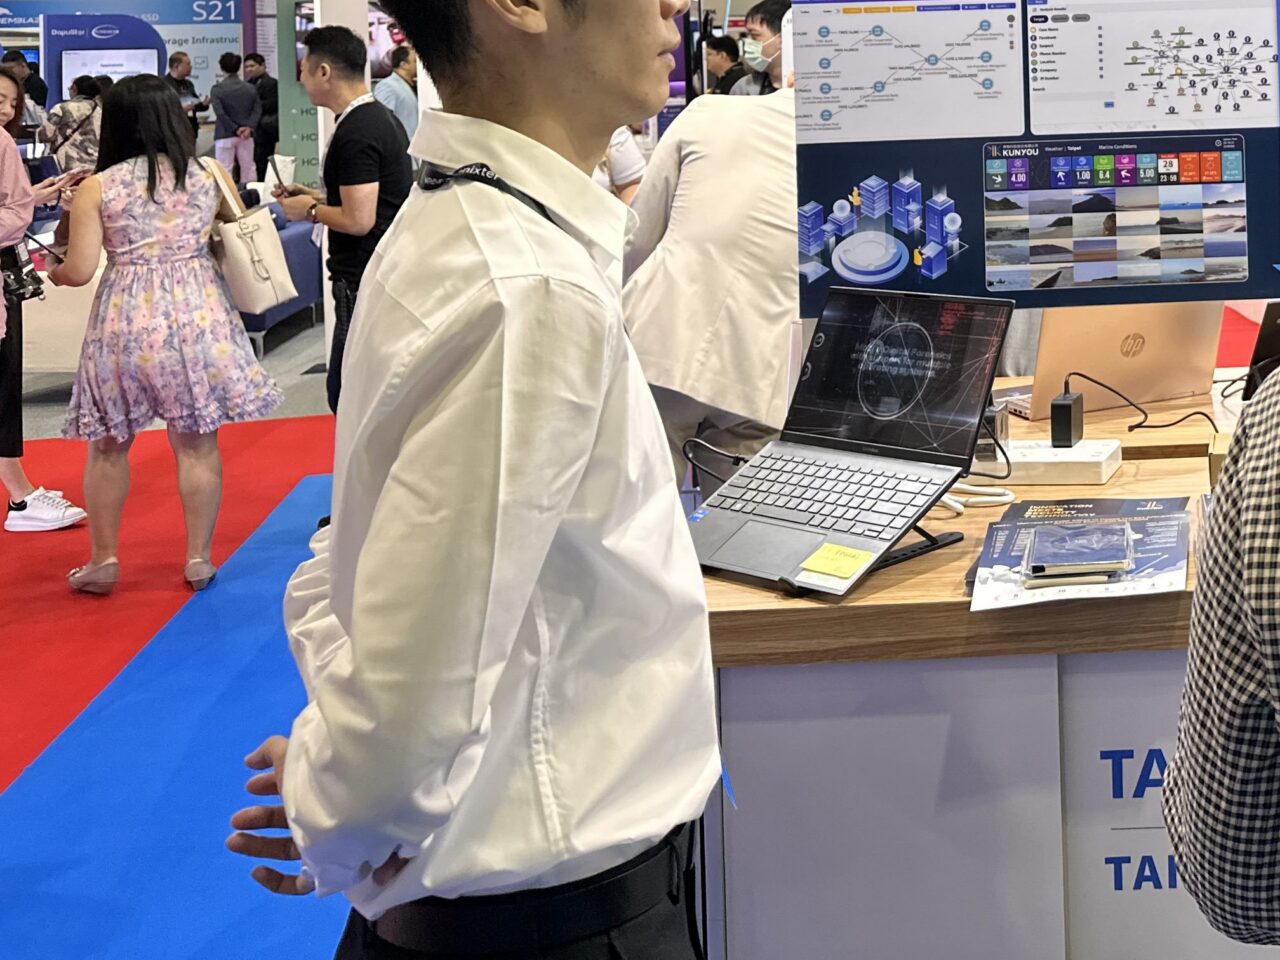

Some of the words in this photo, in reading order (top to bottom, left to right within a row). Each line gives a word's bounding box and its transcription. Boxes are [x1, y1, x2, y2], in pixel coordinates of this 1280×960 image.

[192, 0, 236, 21] S21
[164, 37, 189, 47] orage
[192, 36, 239, 45] Infrastruc
[1003, 148, 1039, 157] KUNYOU
[1011, 173, 1026, 182] 4.00
[1076, 171, 1090, 180] 1.00
[1140, 169, 1154, 178] 5.00
[1163, 160, 1173, 168] 28
[1120, 332, 1145, 359] hp
[1100, 748, 1169, 799] TA
